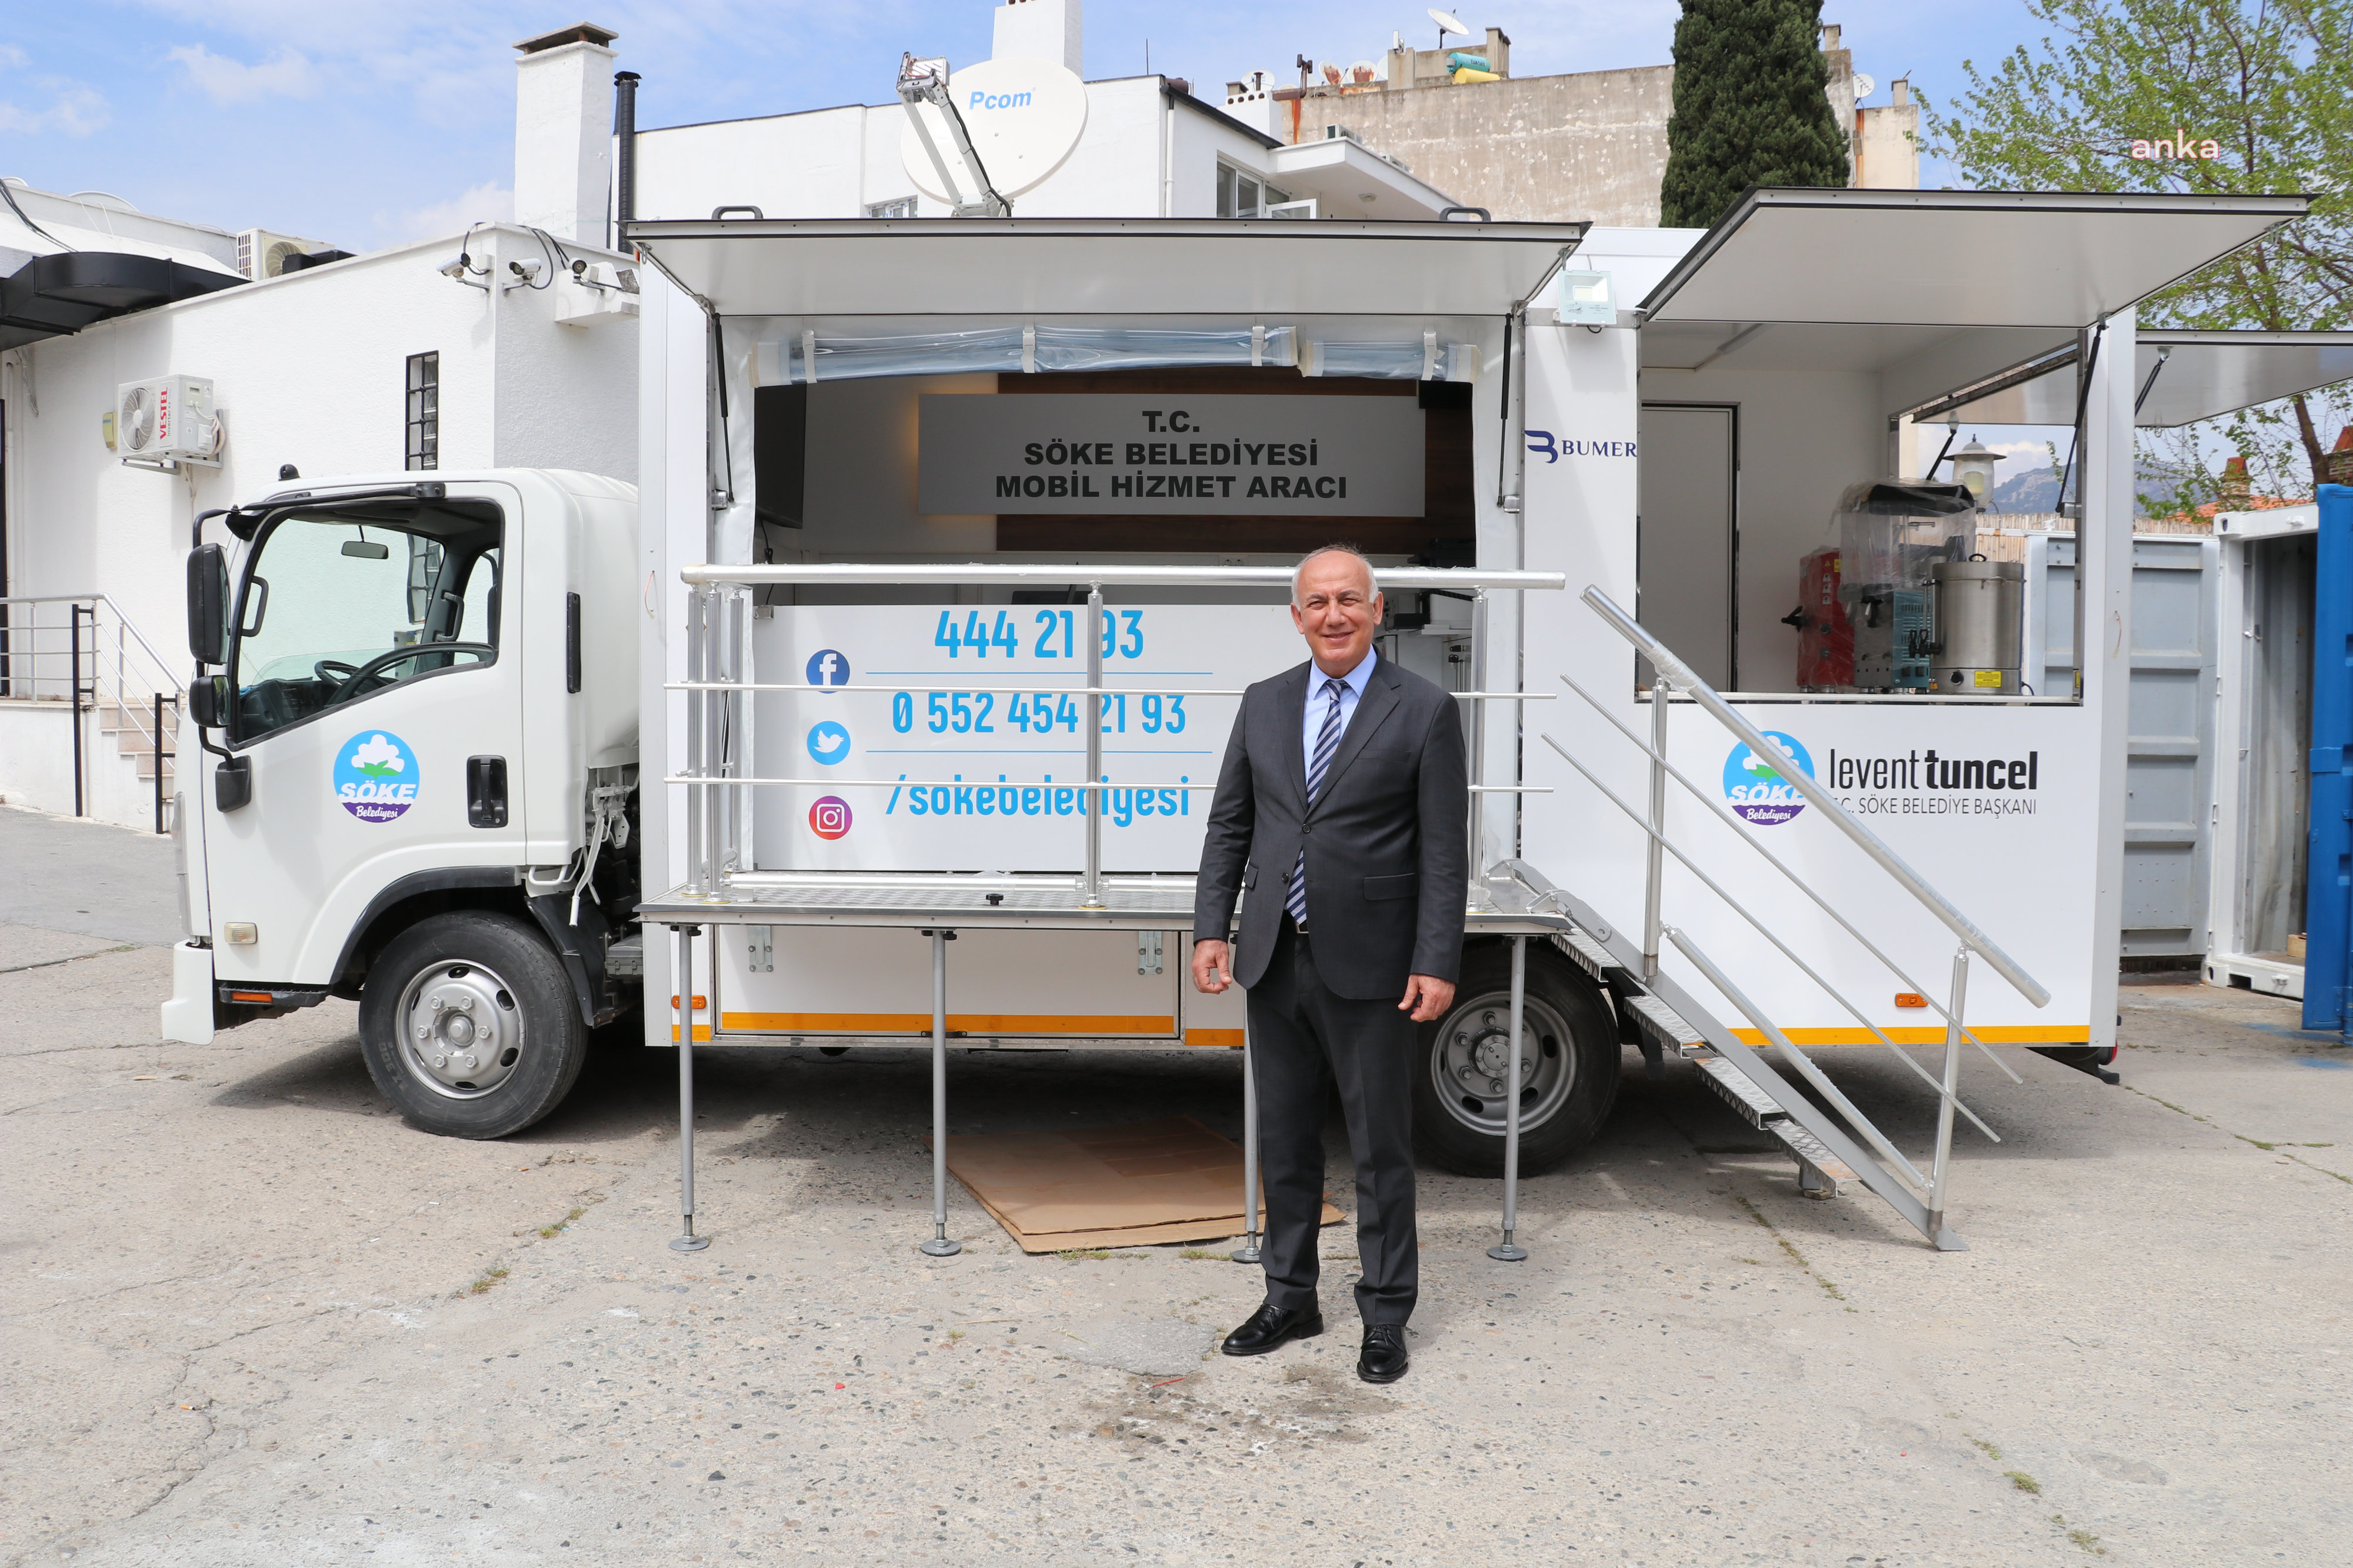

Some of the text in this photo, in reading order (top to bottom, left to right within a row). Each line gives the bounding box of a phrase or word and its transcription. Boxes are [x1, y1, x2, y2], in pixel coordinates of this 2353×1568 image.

[969, 91, 1032, 110] Pcom
[1142, 411, 1200, 432] T.C.
[1024, 438, 1318, 466] SÖKE BELEDİYESİ
[1561, 440, 1638, 457] BUMER
[996, 470, 1347, 499] MOBİL HİZMET ARACI
[935, 610, 1018, 658] 444
[1035, 610, 1073, 658] 21
[893, 692, 912, 733] 0
[928, 692, 994, 733] 552
[1008, 693, 1078, 733] 454
[1142, 694, 1185, 734] 93
[1830, 749, 2038, 790] levent tuncel
[339, 780, 416, 800] SÖKE
[356, 805, 399, 820] Belediyesi
[1747, 808, 1791, 822] Belediyesi
[1859, 794, 1898, 814] SÖKE
[1902, 794, 1969, 814] BELEDİYE
[1974, 798, 2037, 819] BAŞKANI
